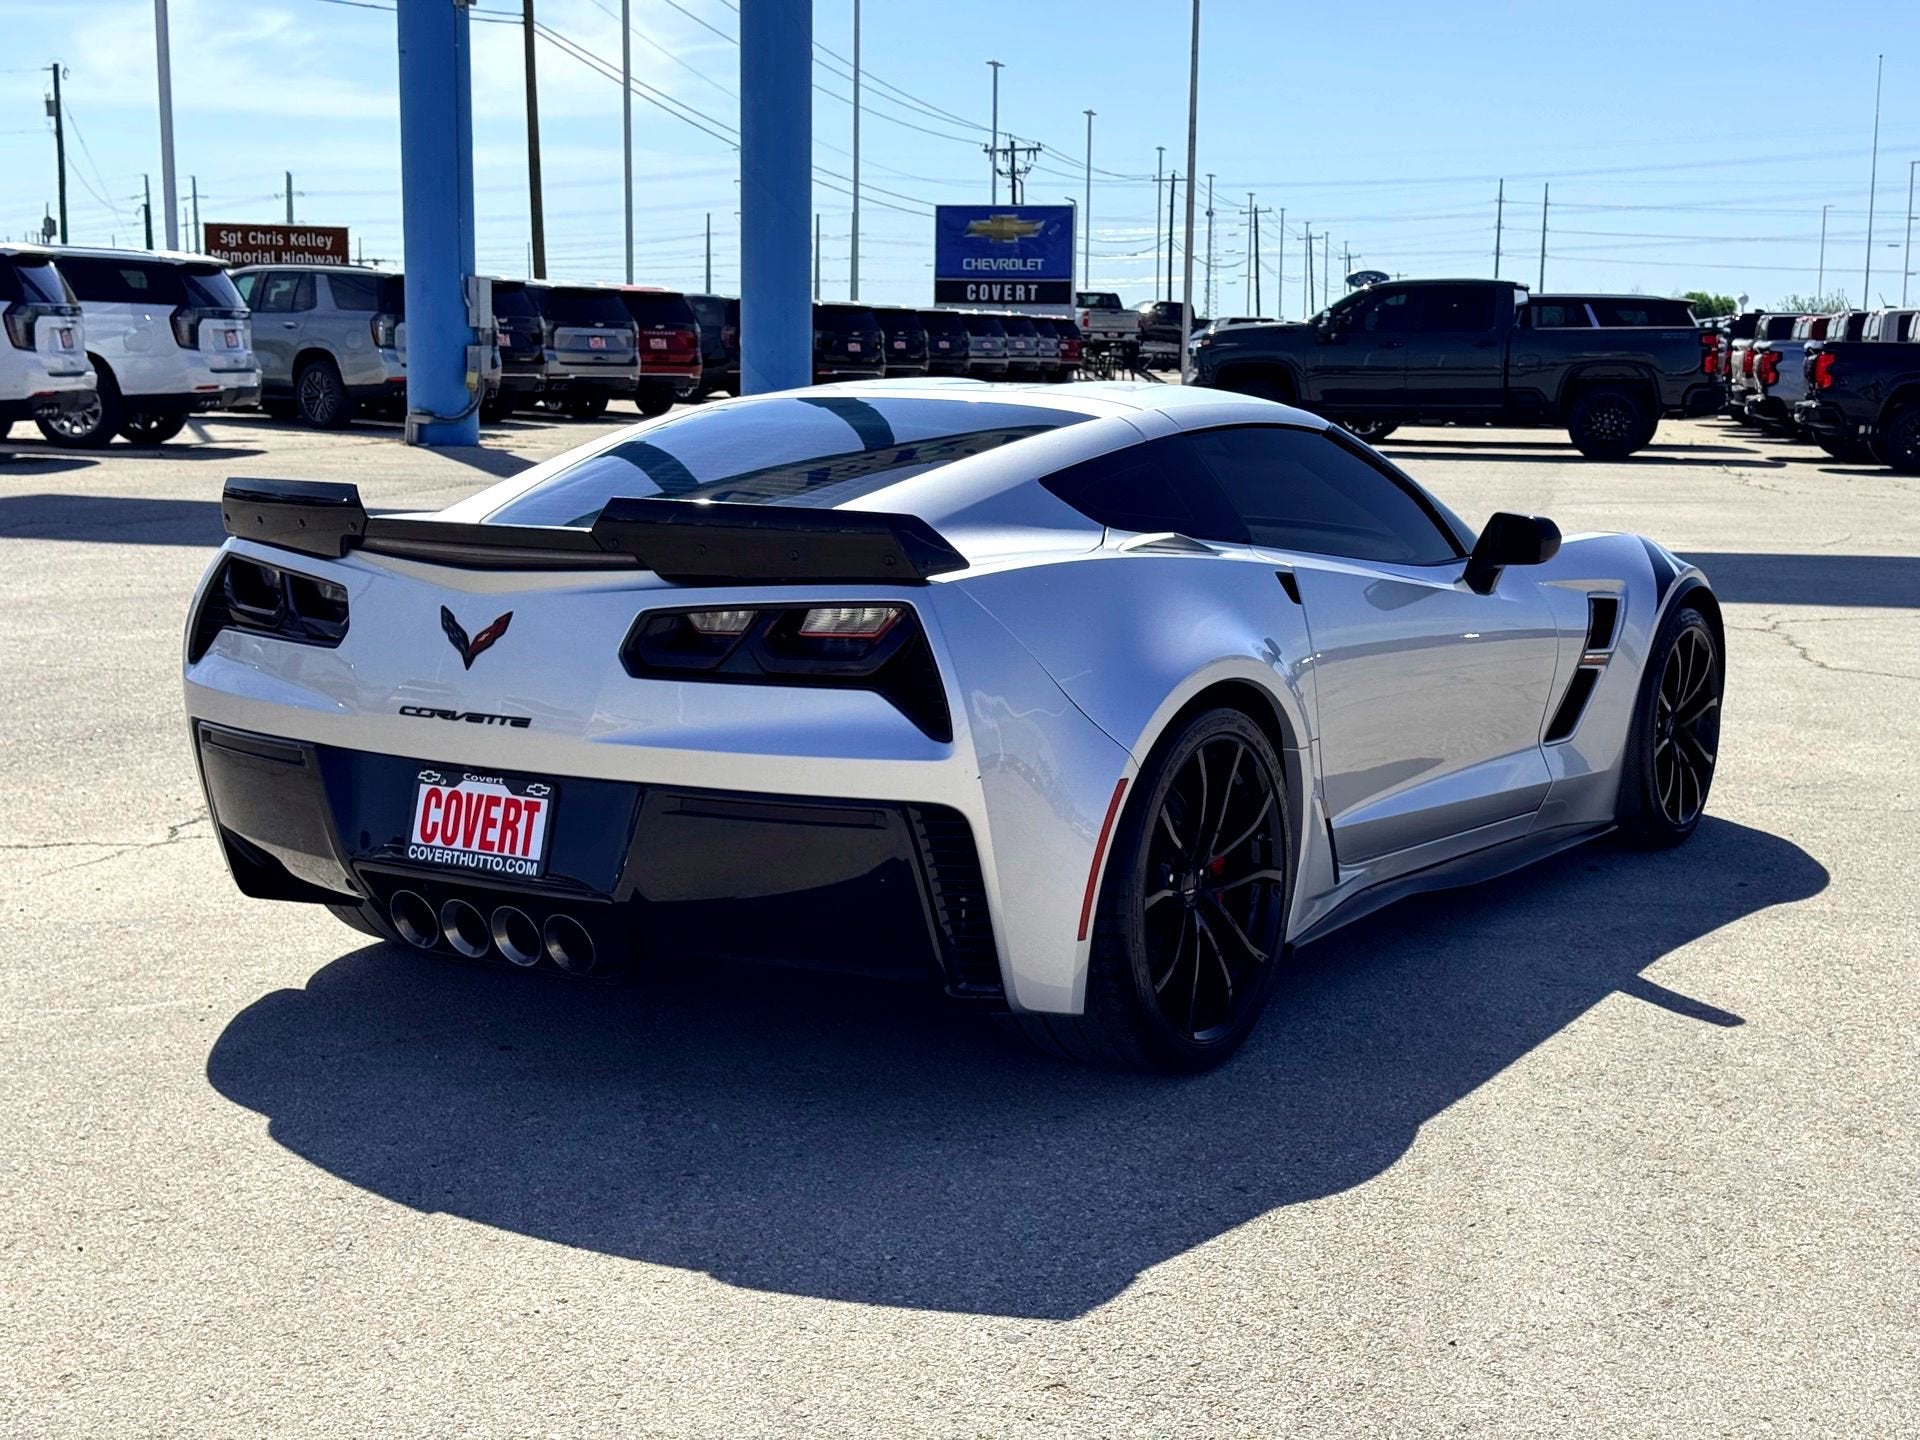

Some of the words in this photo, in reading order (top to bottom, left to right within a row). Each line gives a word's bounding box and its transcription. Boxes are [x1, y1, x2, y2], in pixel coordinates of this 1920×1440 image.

[220, 230, 242, 247] Sgt
[248, 231, 284, 245] Chris
[290, 233, 333, 250] Kelley
[963, 258, 1044, 270] CHEVROLET
[967, 284, 1038, 300] COVERT
[462, 772, 504, 785] Covert
[420, 787, 542, 857] COVERT
[408, 845, 538, 876] COVERTHUTTO.COM
